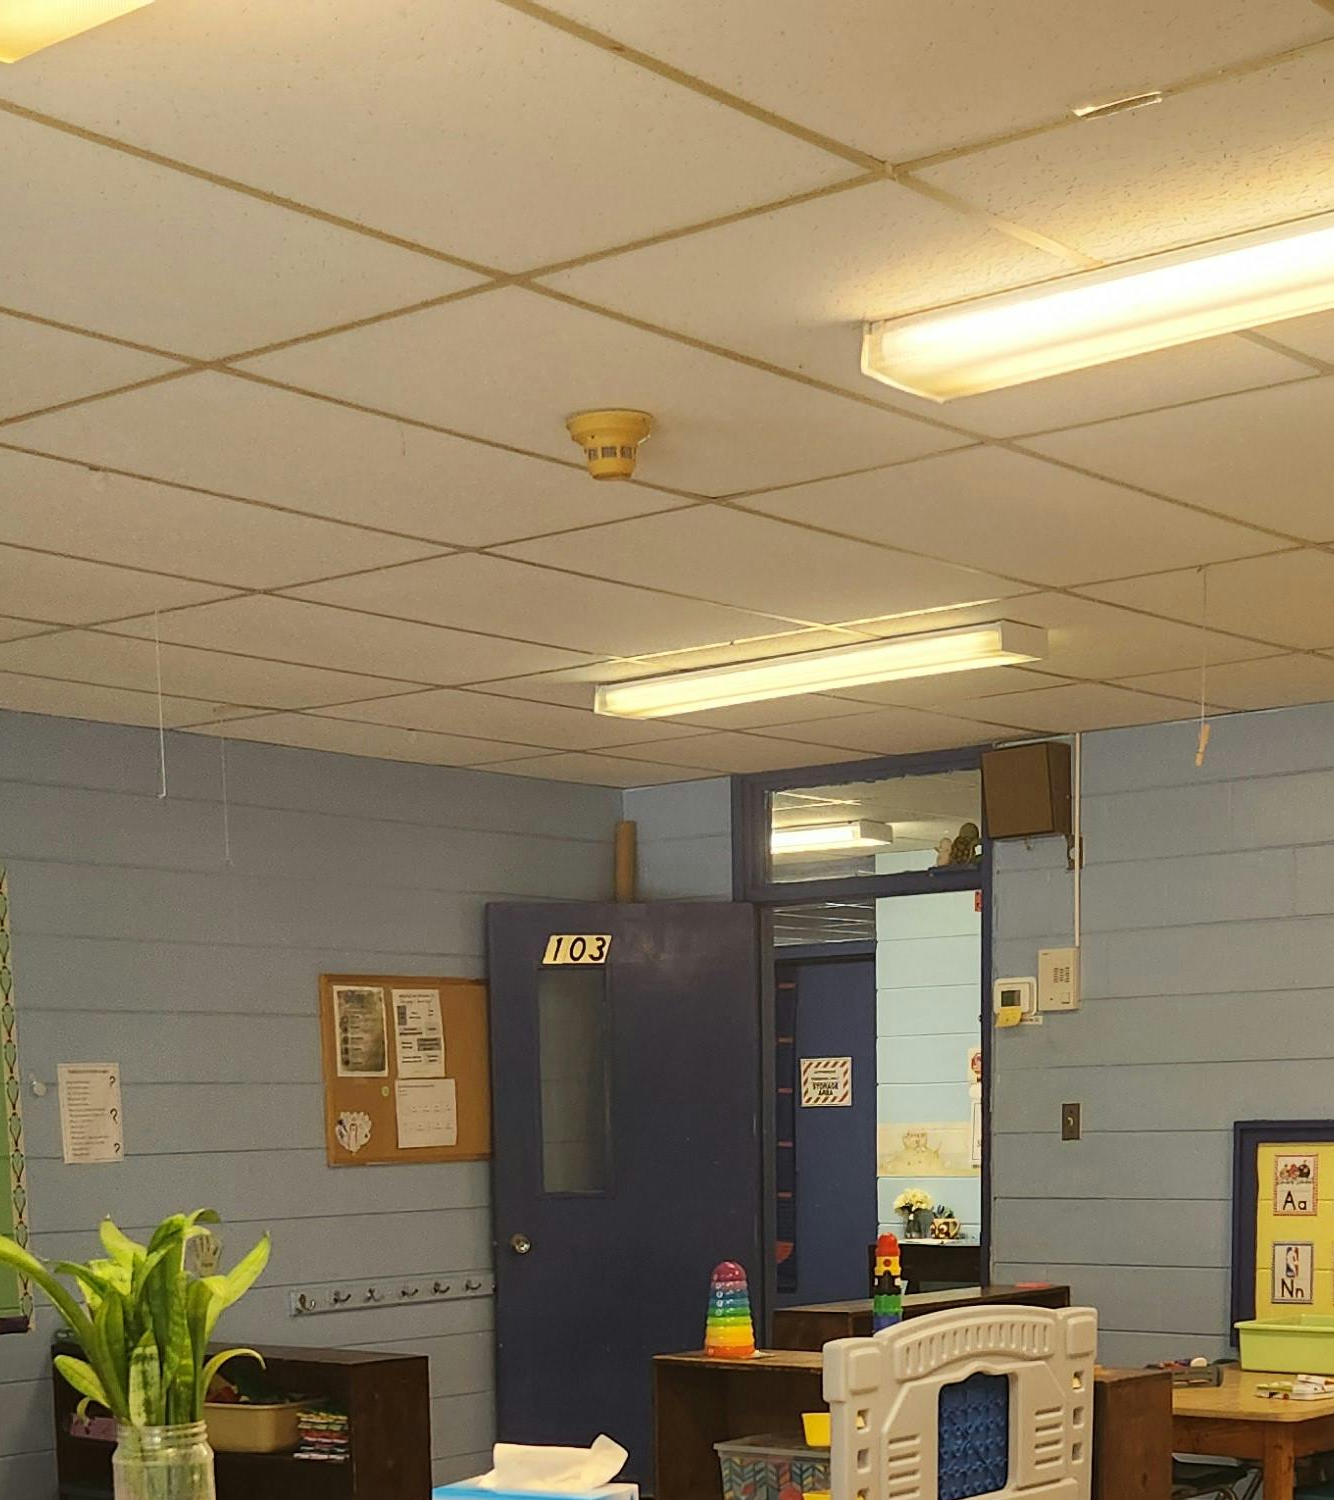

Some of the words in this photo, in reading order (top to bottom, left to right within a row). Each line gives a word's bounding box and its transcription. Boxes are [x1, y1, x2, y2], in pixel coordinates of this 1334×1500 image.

[550, 937, 605, 961] 103
[1282, 1190, 1307, 1211] Aa
[1280, 1278, 1304, 1298] Nn
